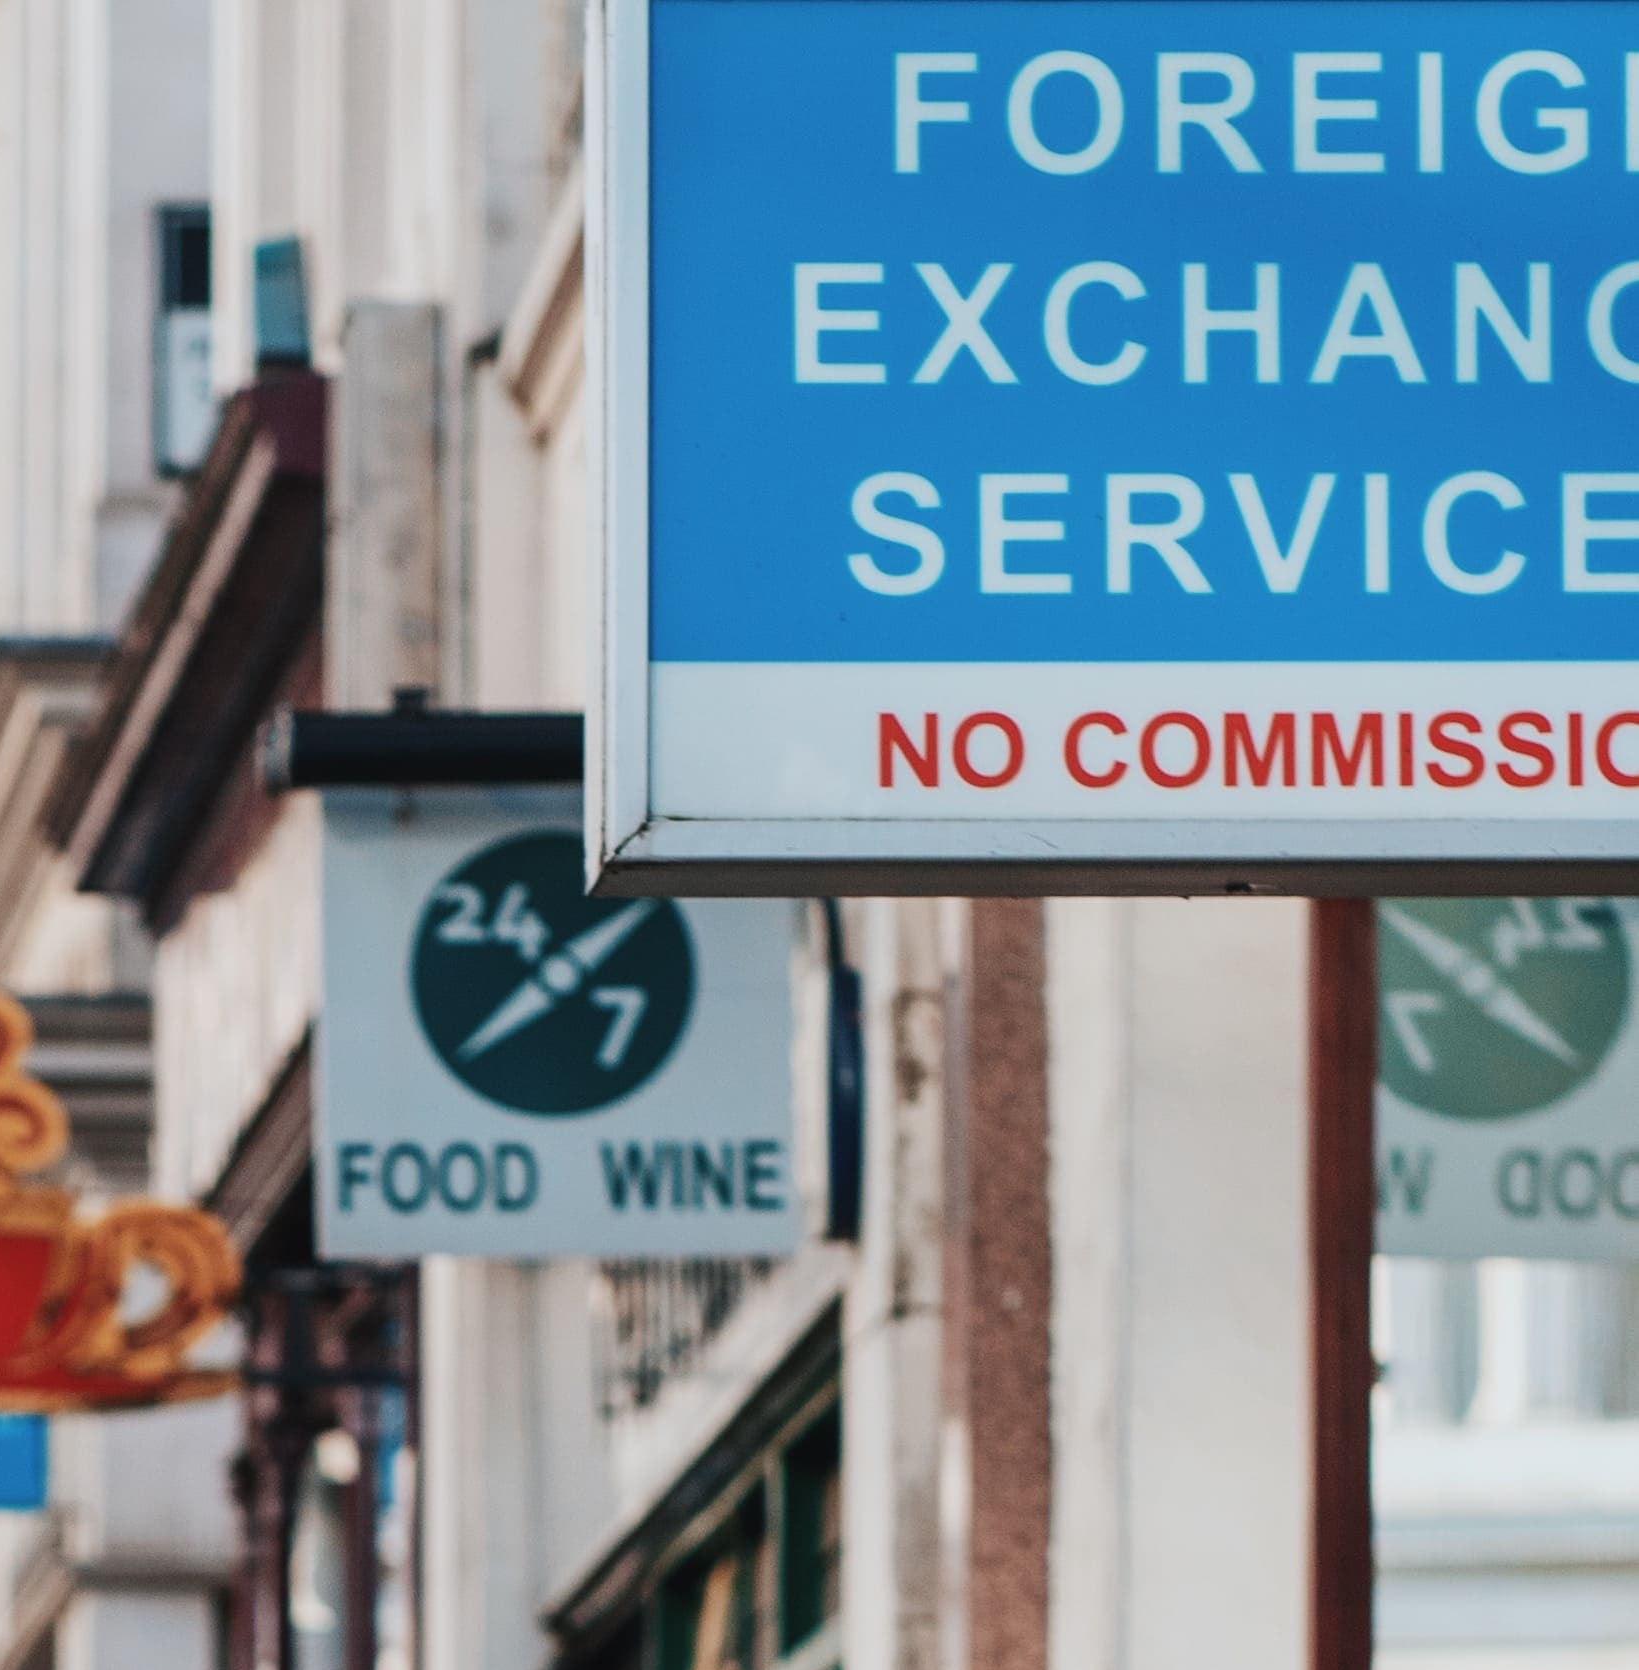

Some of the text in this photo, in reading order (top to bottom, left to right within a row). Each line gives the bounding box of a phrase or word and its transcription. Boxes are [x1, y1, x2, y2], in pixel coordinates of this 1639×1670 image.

[892, 50, 1639, 177] FOREIG
[846, 470, 1639, 597] SERVICE
[877, 711, 1026, 790] NO
[436, 882, 551, 960] 24
[591, 985, 649, 1068] 7
[337, 1139, 786, 1214] FOOD WINE
